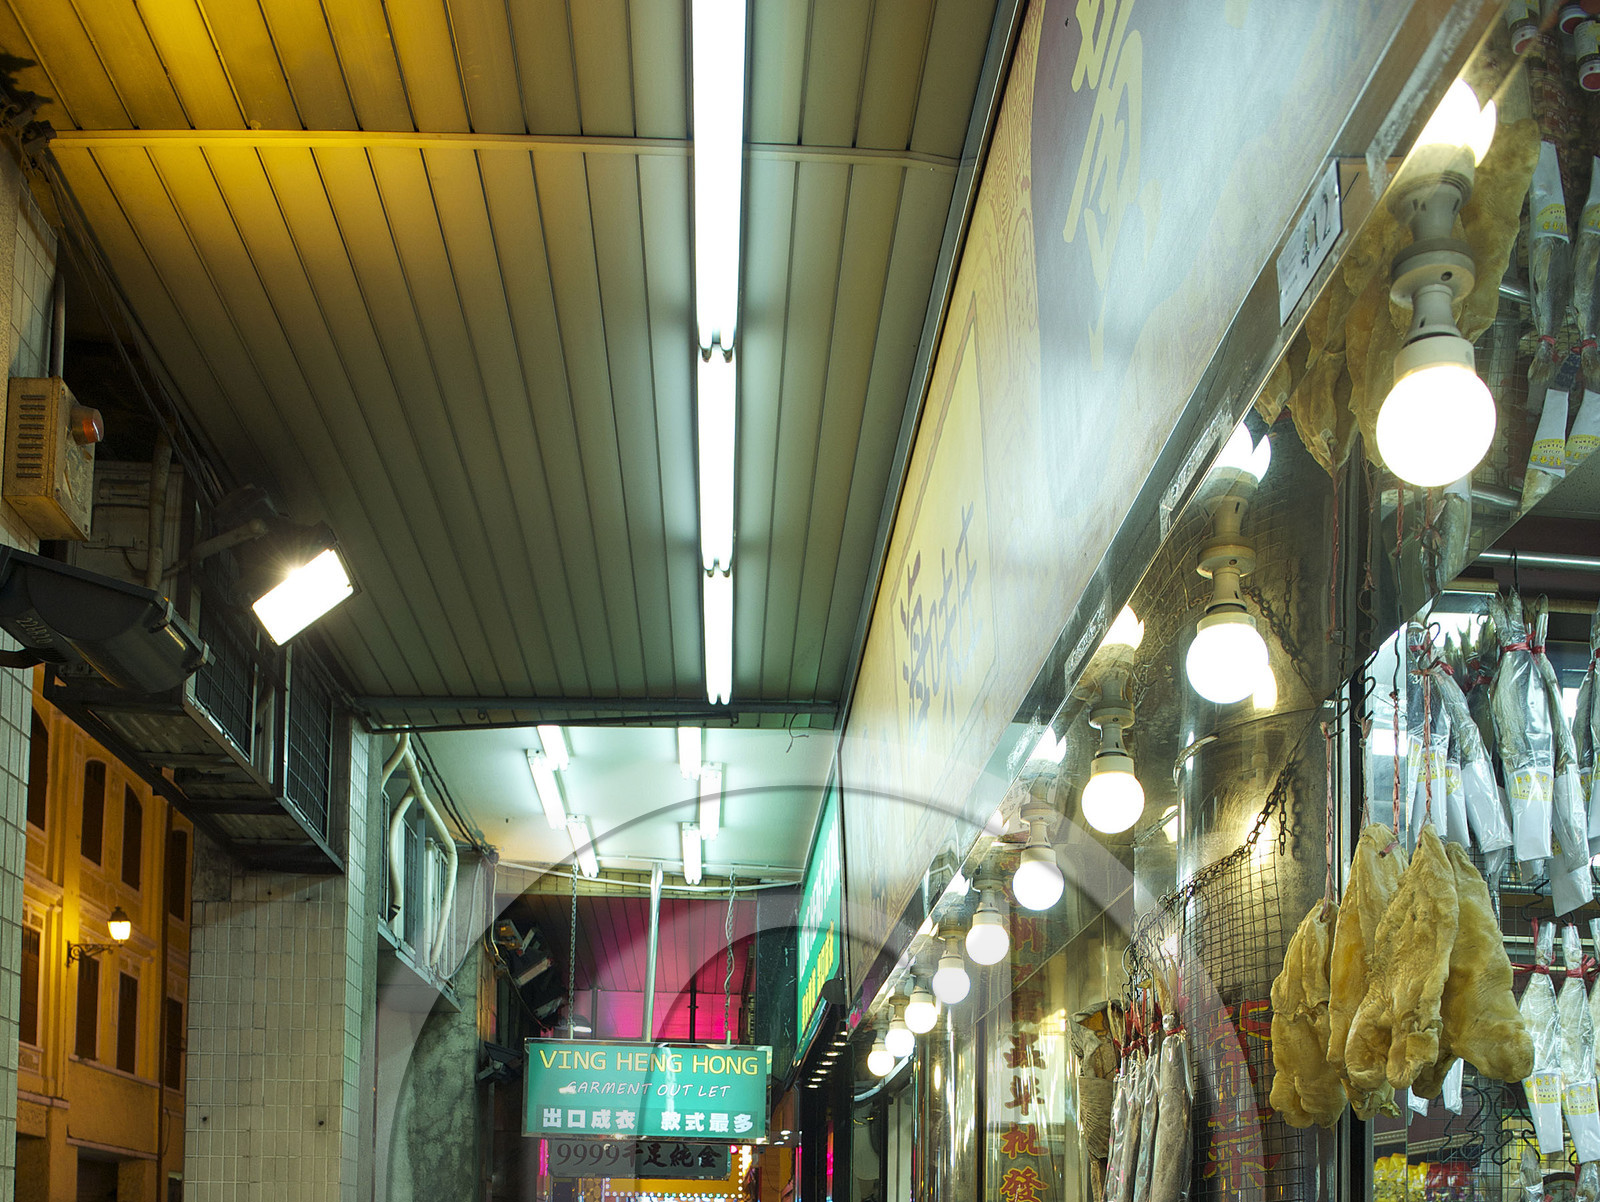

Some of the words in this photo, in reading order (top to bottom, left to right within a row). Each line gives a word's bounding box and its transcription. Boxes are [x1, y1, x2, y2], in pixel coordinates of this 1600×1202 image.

[539, 1049, 607, 1071] VING
[616, 1052, 683, 1074] HENG
[692, 1054, 759, 1076] HONG
[565, 1081, 653, 1096] GARMENT
[657, 1083, 693, 1096] OUT
[698, 1085, 731, 1098] LET
[542, 1108, 636, 1130] 出口成衣
[661, 1110, 754, 1133] 款式最多
[556, 1142, 723, 1169] 9999千足純金
